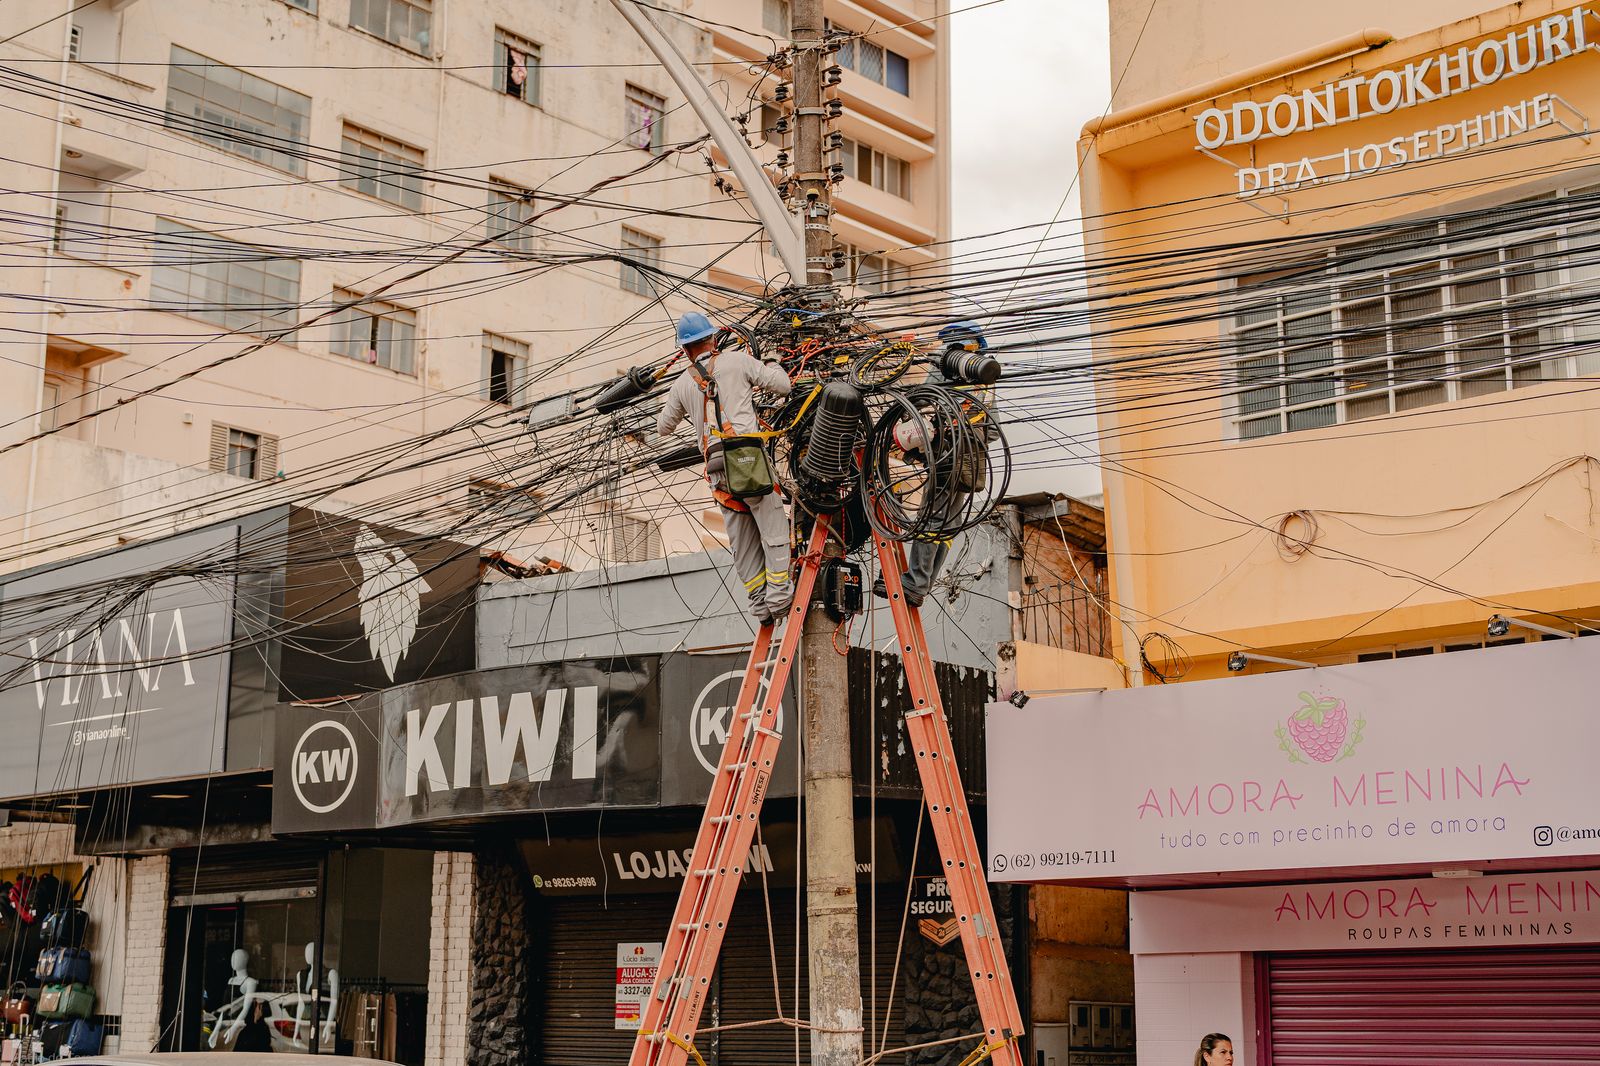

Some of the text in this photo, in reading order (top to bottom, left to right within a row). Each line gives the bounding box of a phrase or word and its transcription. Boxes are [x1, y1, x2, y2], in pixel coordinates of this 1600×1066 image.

[1194, 6, 1588, 150] ODONTOKHOURI
[1342, 92, 1555, 182] JOSEPHINE
[28, 608, 195, 710] VIANA
[405, 685, 598, 797] KIWI
[298, 747, 352, 785] KW
[1137, 762, 1531, 820] AMORA MENINA
[1160, 814, 1507, 849] tudo com precinho de amora
[1010, 849, 1116, 872] (62) 99219-7111
[552, 876, 597, 888] 98263-9998
[910, 900, 954, 915] SEGUR
[1274, 886, 1437, 922] AMORA
[1348, 921, 1574, 940] ROUPAS FEMININAS
[624, 986, 652, 995] 3327-00
[688, 990, 700, 1022] TELEMONT
